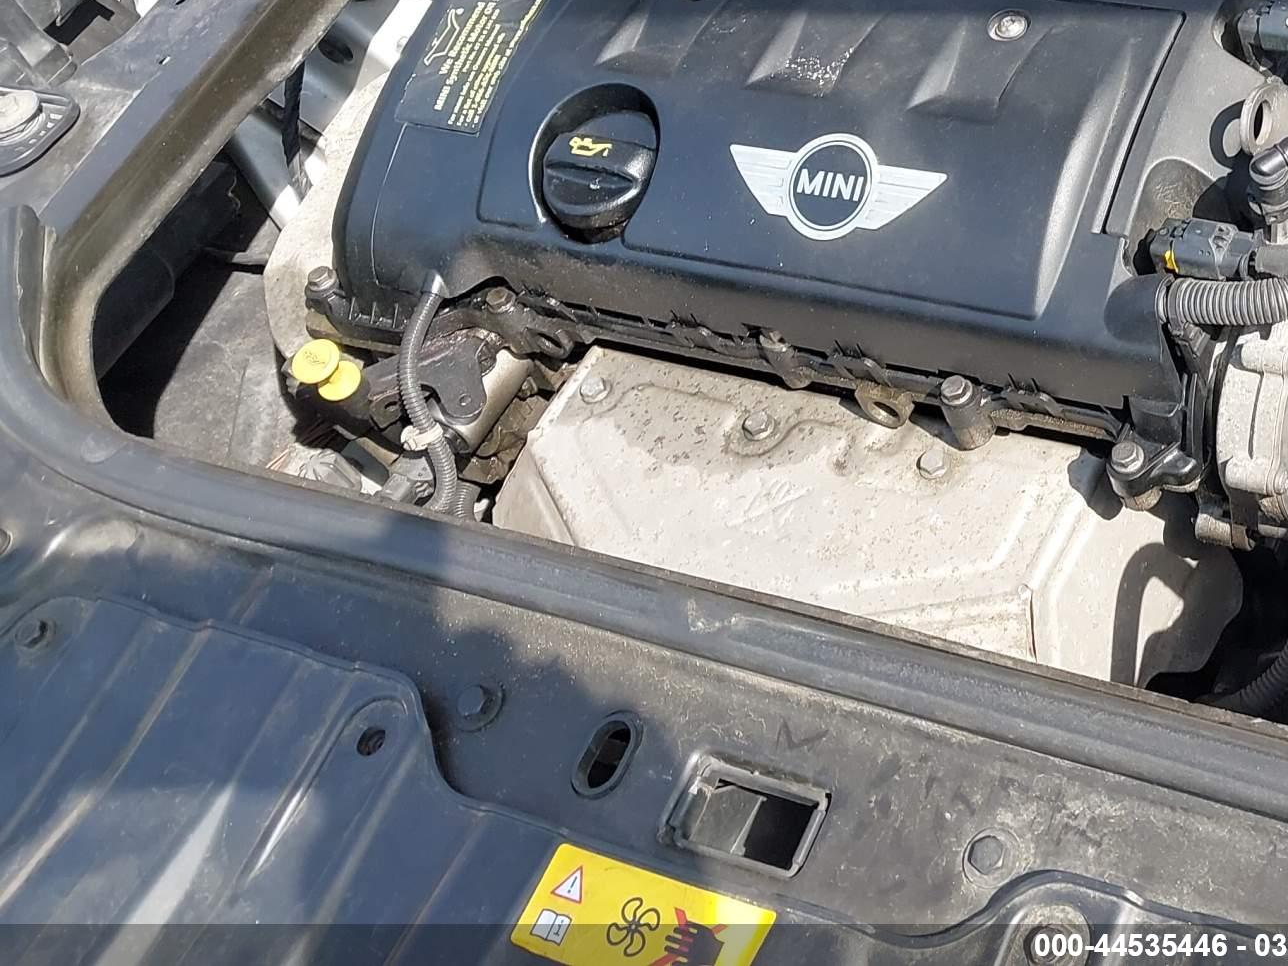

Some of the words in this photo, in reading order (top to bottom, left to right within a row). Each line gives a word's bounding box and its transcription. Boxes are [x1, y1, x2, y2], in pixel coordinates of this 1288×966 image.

[433, 85, 451, 111] MINI
[445, 42, 473, 85] Synthetic
[466, 14, 488, 43] Motor
[438, 57, 454, 75] We
[447, 1, 486, 58] Recommend
[796, 168, 865, 202] MINI
